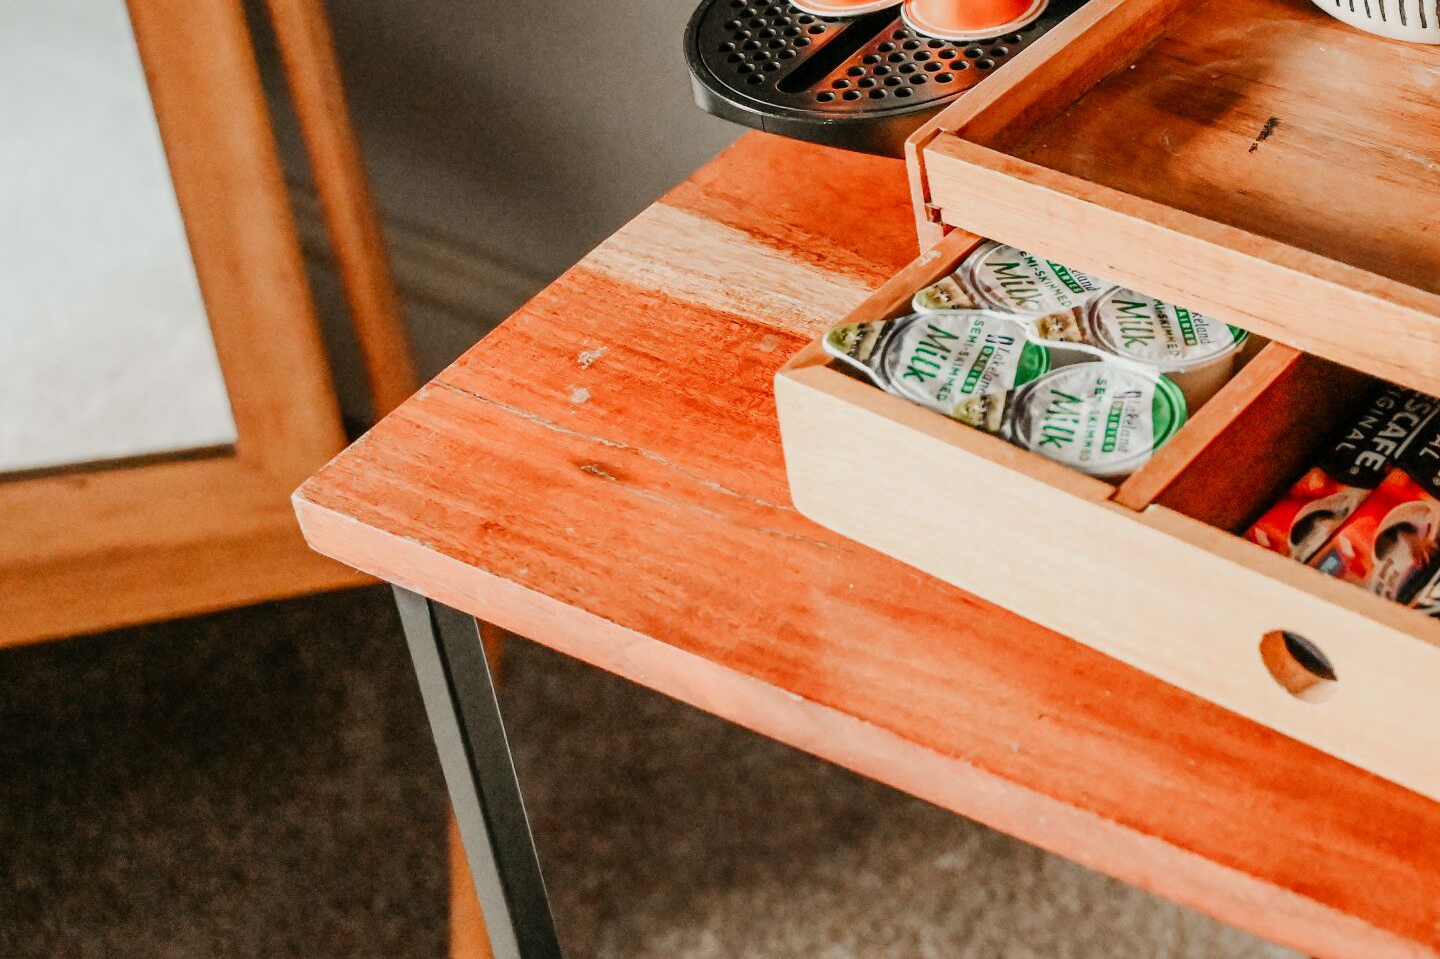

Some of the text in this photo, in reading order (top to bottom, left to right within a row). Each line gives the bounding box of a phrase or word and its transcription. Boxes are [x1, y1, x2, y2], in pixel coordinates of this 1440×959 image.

[1020, 250, 1072, 307] EMI-SKIMMED
[1052, 263, 1082, 293] AIRIES
[1192, 312, 1215, 345] keland
[1335, 390, 1400, 451] IGINAL
